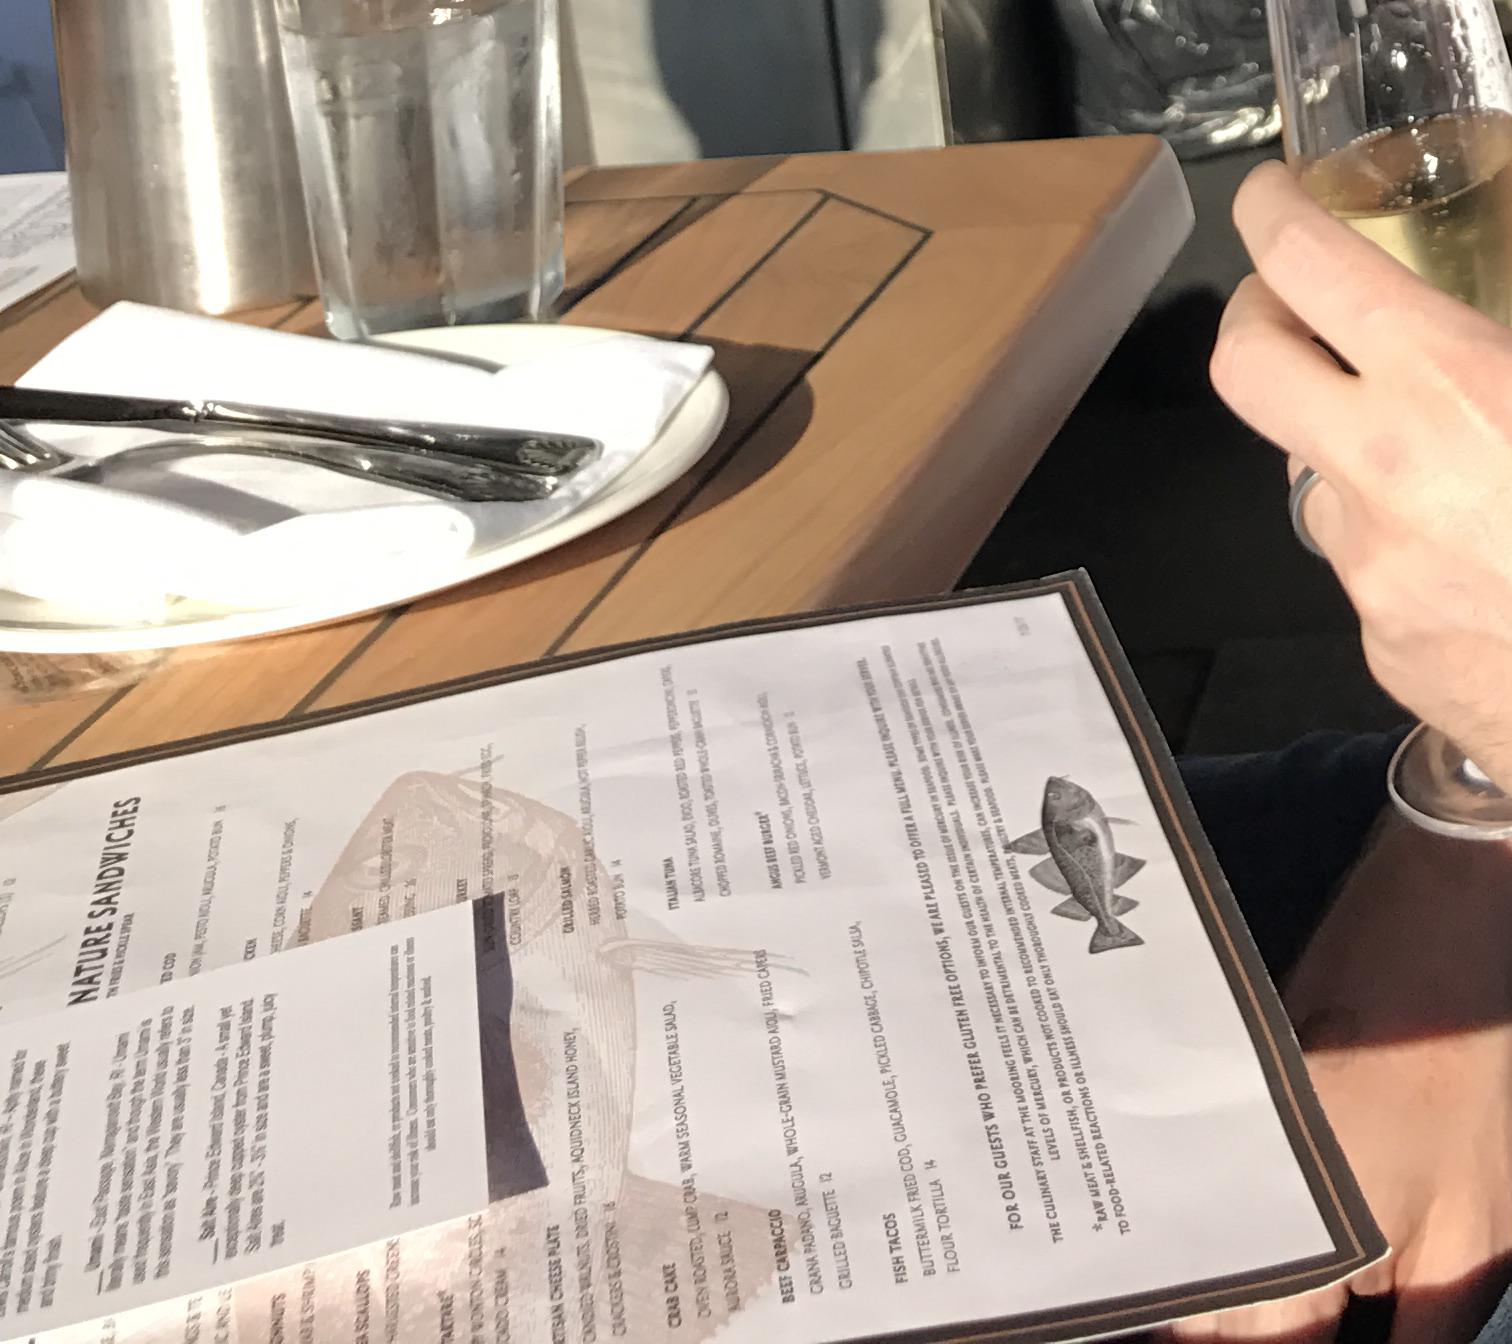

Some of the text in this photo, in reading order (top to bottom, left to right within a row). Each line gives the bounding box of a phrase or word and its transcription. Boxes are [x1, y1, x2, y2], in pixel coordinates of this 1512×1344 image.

[897, 793, 912, 814] FULL
[975, 811, 987, 826] CAN
[904, 821, 921, 847] OFFER
[763, 846, 777, 863] BEEF
[911, 848, 925, 860] TO
[662, 856, 679, 910] ITALIAN TUNA
[767, 863, 782, 889] ANGUS
[915, 861, 936, 900] PLEASED
[67, 796, 141, 1005] NATURE SANDWICHES
[558, 865, 574, 933] GRILLED SALMON
[925, 902, 941, 919] ARE
[997, 880, 1015, 915] INTERNAL
[1013, 881, 1031, 911] COOKED
[930, 921, 944, 935] WE
[1007, 916, 1033, 974] RECOMMENDED
[1023, 912, 1047, 963] THOROUGHLY
[752, 949, 770, 979] CAPERS
[853, 948, 874, 989] CHIPOTLE
[935, 936, 958, 982] OPTIONS,
[1039, 964, 1054, 985] ONLY
[758, 980, 774, 1006] FRIED
[947, 983, 965, 1006] FREE
[1025, 975, 1037, 987] TO
[1046, 986, 1060, 1001] EAT
[662, 1000, 677, 1031] SALAD,
[863, 990, 883, 1033] CABBAGE,
[963, 852, 1060, 1160] LEVELS OF MERCURY, WHICH CAN BE DETRIMENTAL TO THE HEALTH OF CERTAIN
[1029, 988, 1049, 1022] COOKED
[1051, 1002, 1071, 1035] SHOULD
[563, 1027, 578, 1063] HONEY,
[954, 1008, 976, 1049] GLUTEN
[1040, 1023, 1054, 1040] NOT
[665, 1032, 682, 1085] VEGETABLE
[768, 1035, 786, 1080] MUSTARD
[872, 1034, 891, 1074] PICKLED
[949, 863, 1063, 1243] THE CULINARY STAFF AT THE MOORING FEELS IT NECESSARY TO INFORM OUR GUESTS ON THE
[966, 1051, 987, 1090] PREFER
[1046, 1041, 1069, 1088] PRODUCTS
[1062, 1036, 1081, 1069] ILLNESS
[565, 1064, 579, 1099] ISLAND
[1073, 1070, 1086, 1084] OR
[672, 1084, 689, 1139] SEASONAL
[881, 1074, 907, 1142] GUACAMOLE,
[977, 1092, 995, 1122] WHO
[1060, 1089, 1073, 1104] OR
[1077, 1086, 1103, 1140] REACTIONS
[567, 1100, 584, 1163] AQUIDNECK
[776, 1082, 798, 1156] WHOLE-GRAIN
[1065, 1105, 1090, 1160] SHELLFISH,
[677, 1139, 692, 1172] WARM
[897, 1143, 913, 1172] COD,
[984, 1123, 1007, 1168] GUESTS
[788, 1155, 808, 1206] ARUGULA,
[1081, 1161, 1092, 1169] &
[1094, 1142, 1126, 1217] FOOD-RELATED
[571, 1164, 587, 1206] FRUITS,
[902, 1173, 921, 1202] FRIED
[997, 1171, 1015, 1200] OUR
[1083, 1171, 1100, 1197] MEAT
[818, 1171, 852, 1289] GRILLED BAGUETTE 12
[923, 1159, 960, 1272] FLOUR TORTILLA 14
[1005, 1202, 1023, 1230] FOR
[1117, 1219, 1130, 1235] TO
[767, 1208, 795, 1304] BEEF CARPACCIO
[882, 1212, 908, 1284] FISH TACOS
[909, 1203, 936, 1276] BUTTERMILK
[805, 1254, 823, 1294] GRANA
[662, 1262, 682, 1328] CRAB CAKE
